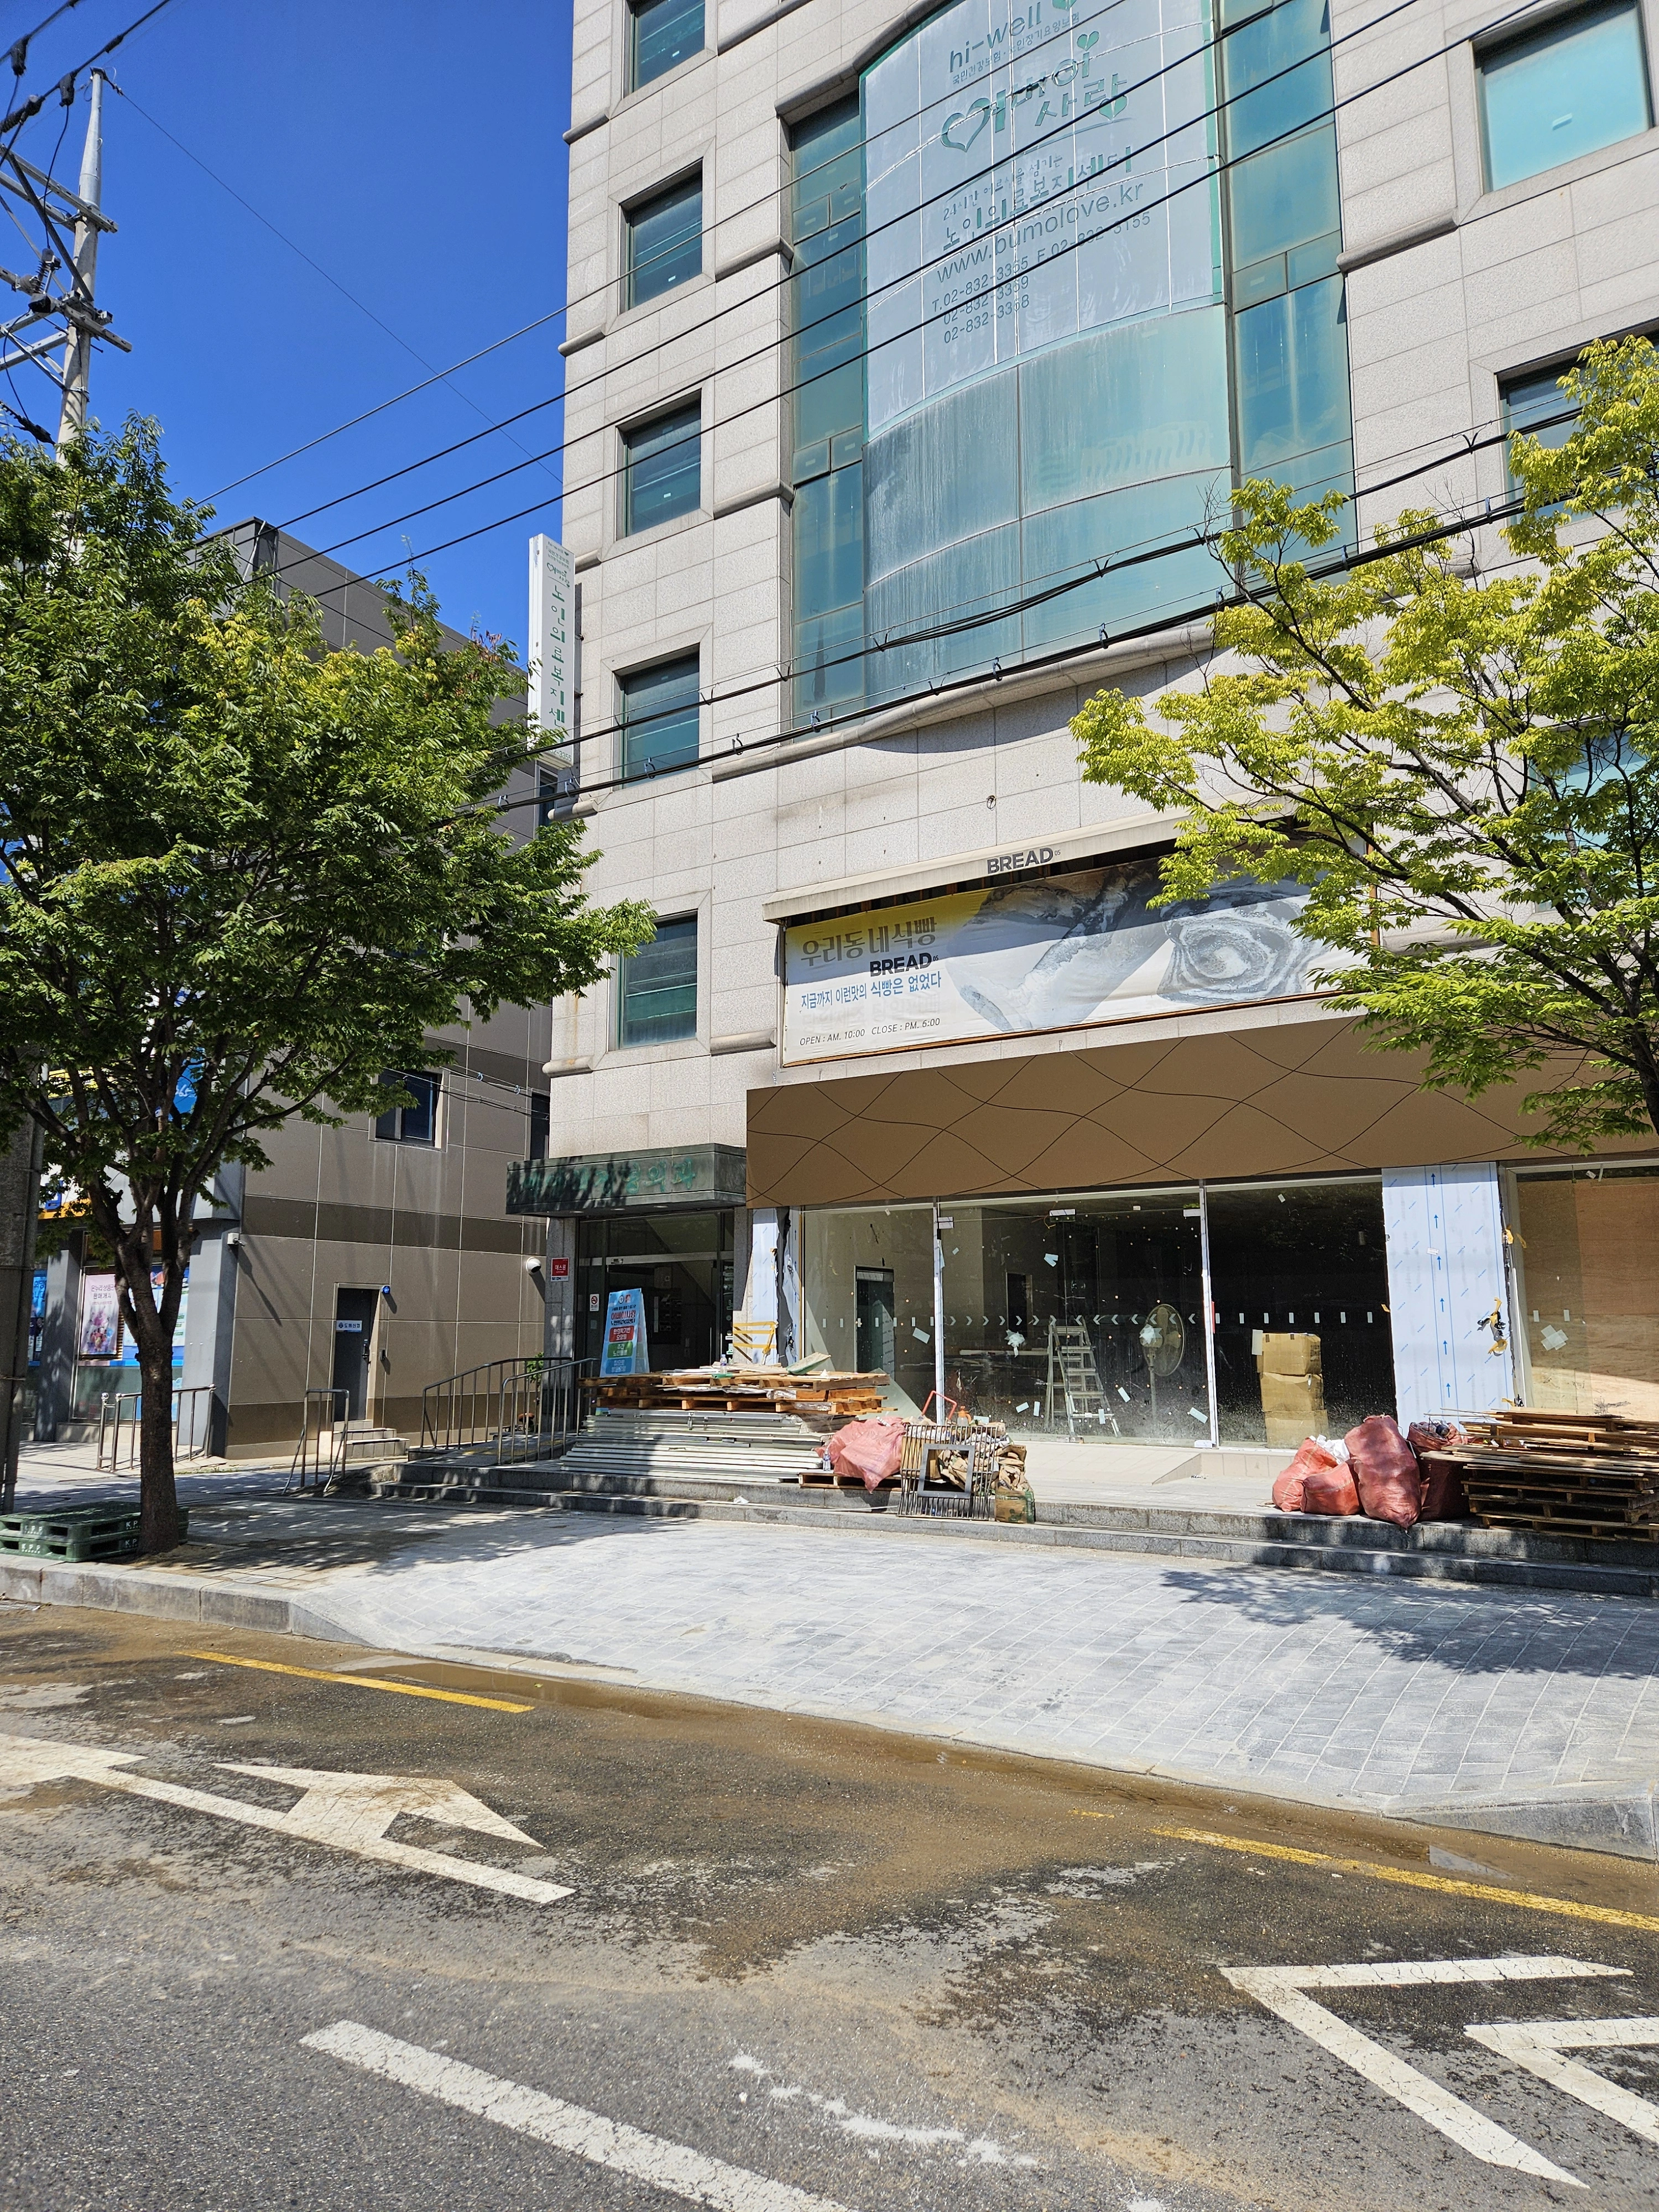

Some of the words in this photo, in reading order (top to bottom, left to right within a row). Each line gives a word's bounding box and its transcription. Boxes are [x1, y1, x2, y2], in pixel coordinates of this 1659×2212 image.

[950, 2, 1041, 73] hi-well
[952, 50, 1000, 84] 국민건강보험
[1009, 12, 1079, 54] 노인장기요양보험
[943, 190, 979, 221] 24시간
[1029, 153, 1063, 177] 섬기는
[943, 146, 1131, 251] 노인의료복지센터
[937, 183, 1144, 283] www.bumolove.kr
[548, 585, 565, 744] 노인의료복지센
[987, 847, 1053, 874] BREAD
[801, 916, 937, 967] 우리동네식빵
[870, 952, 932, 977] BREAD
[801, 989, 832, 1009] 지금까지
[836, 983, 867, 1004] 이런맛의
[870, 978, 904, 998] 식빵은
[908, 971, 941, 993] 없었다
[800, 1035, 821, 1046] OPEN
[827, 1032, 841, 1042] AM.
[844, 1029, 865, 1039] 10:00
[872, 1024, 898, 1035] CLOSE
[905, 1022, 919, 1031] PM.
[922, 1018, 940, 1027] 6:00
